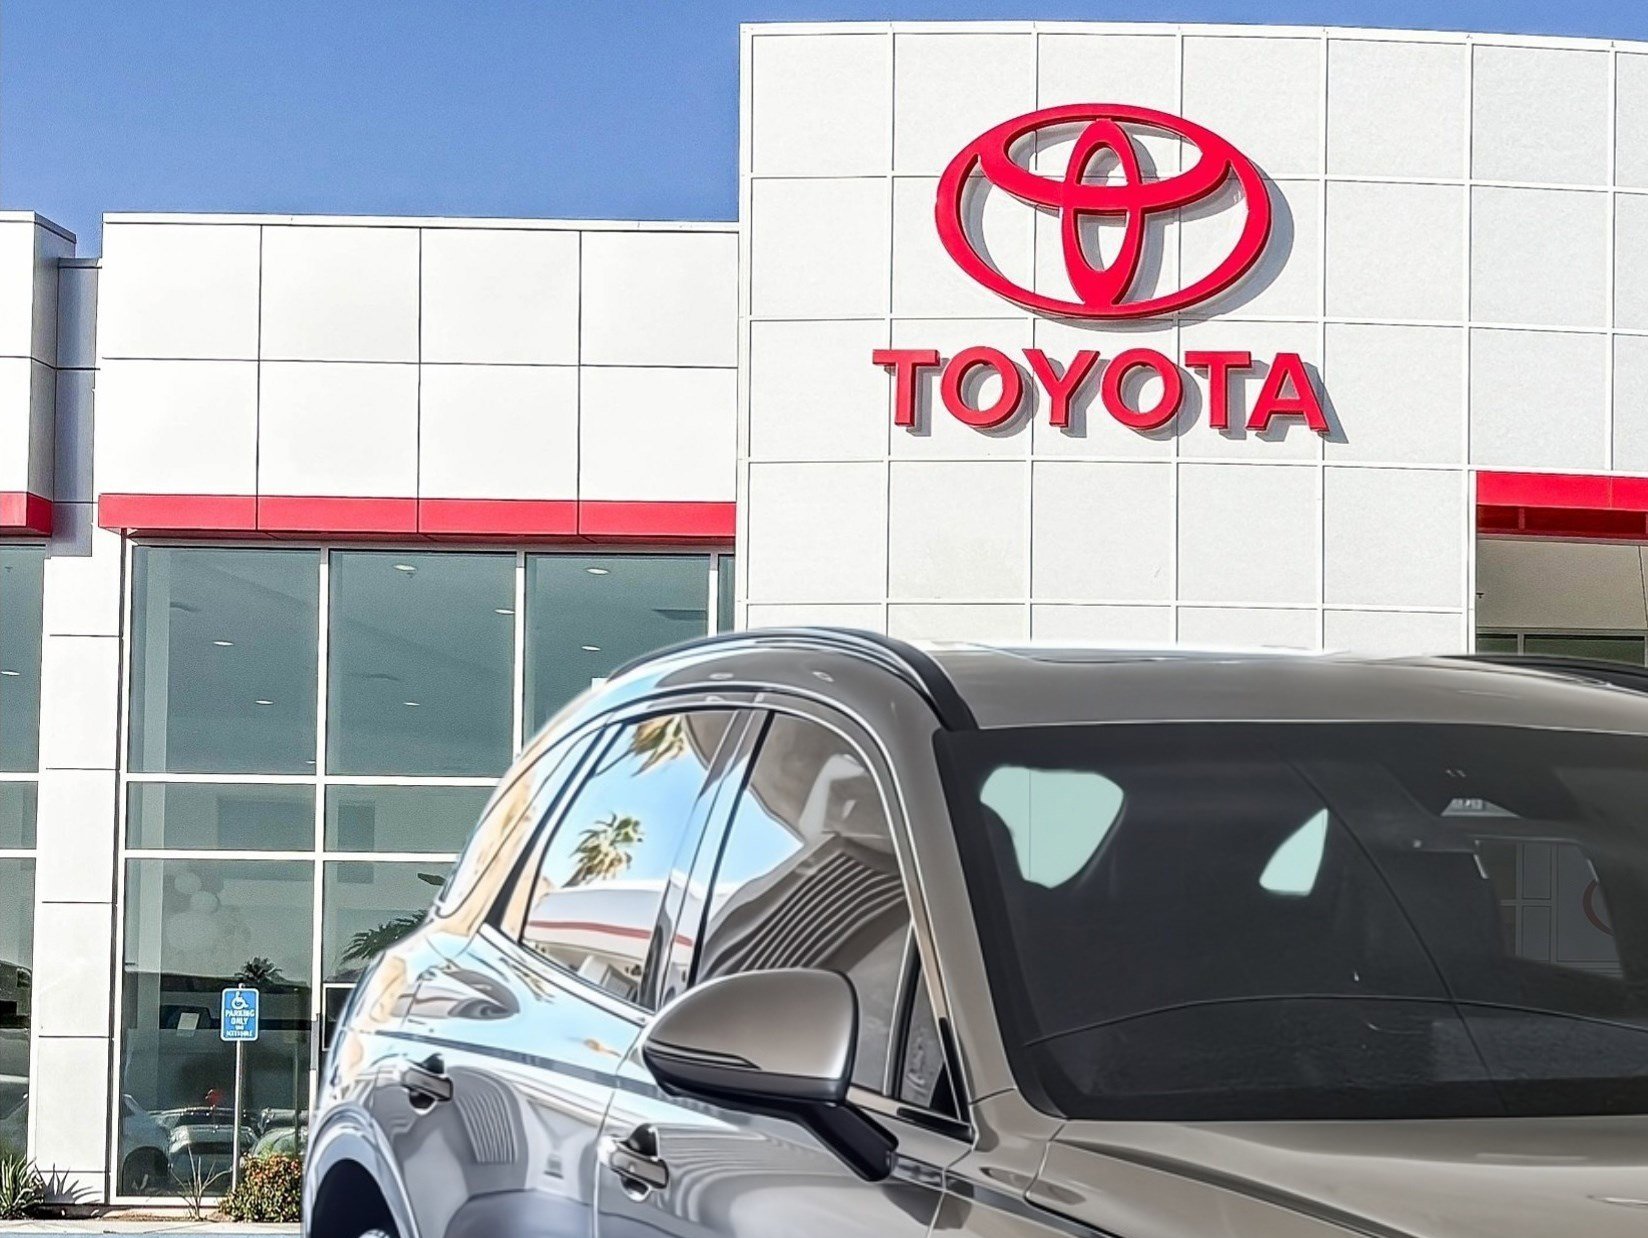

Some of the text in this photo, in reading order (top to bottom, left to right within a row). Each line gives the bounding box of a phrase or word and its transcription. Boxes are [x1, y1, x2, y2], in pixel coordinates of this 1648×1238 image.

[872, 346, 1330, 433] TOYOTA
[225, 1009, 255, 1017] PARKING
[231, 1017, 249, 1025] ONLY
